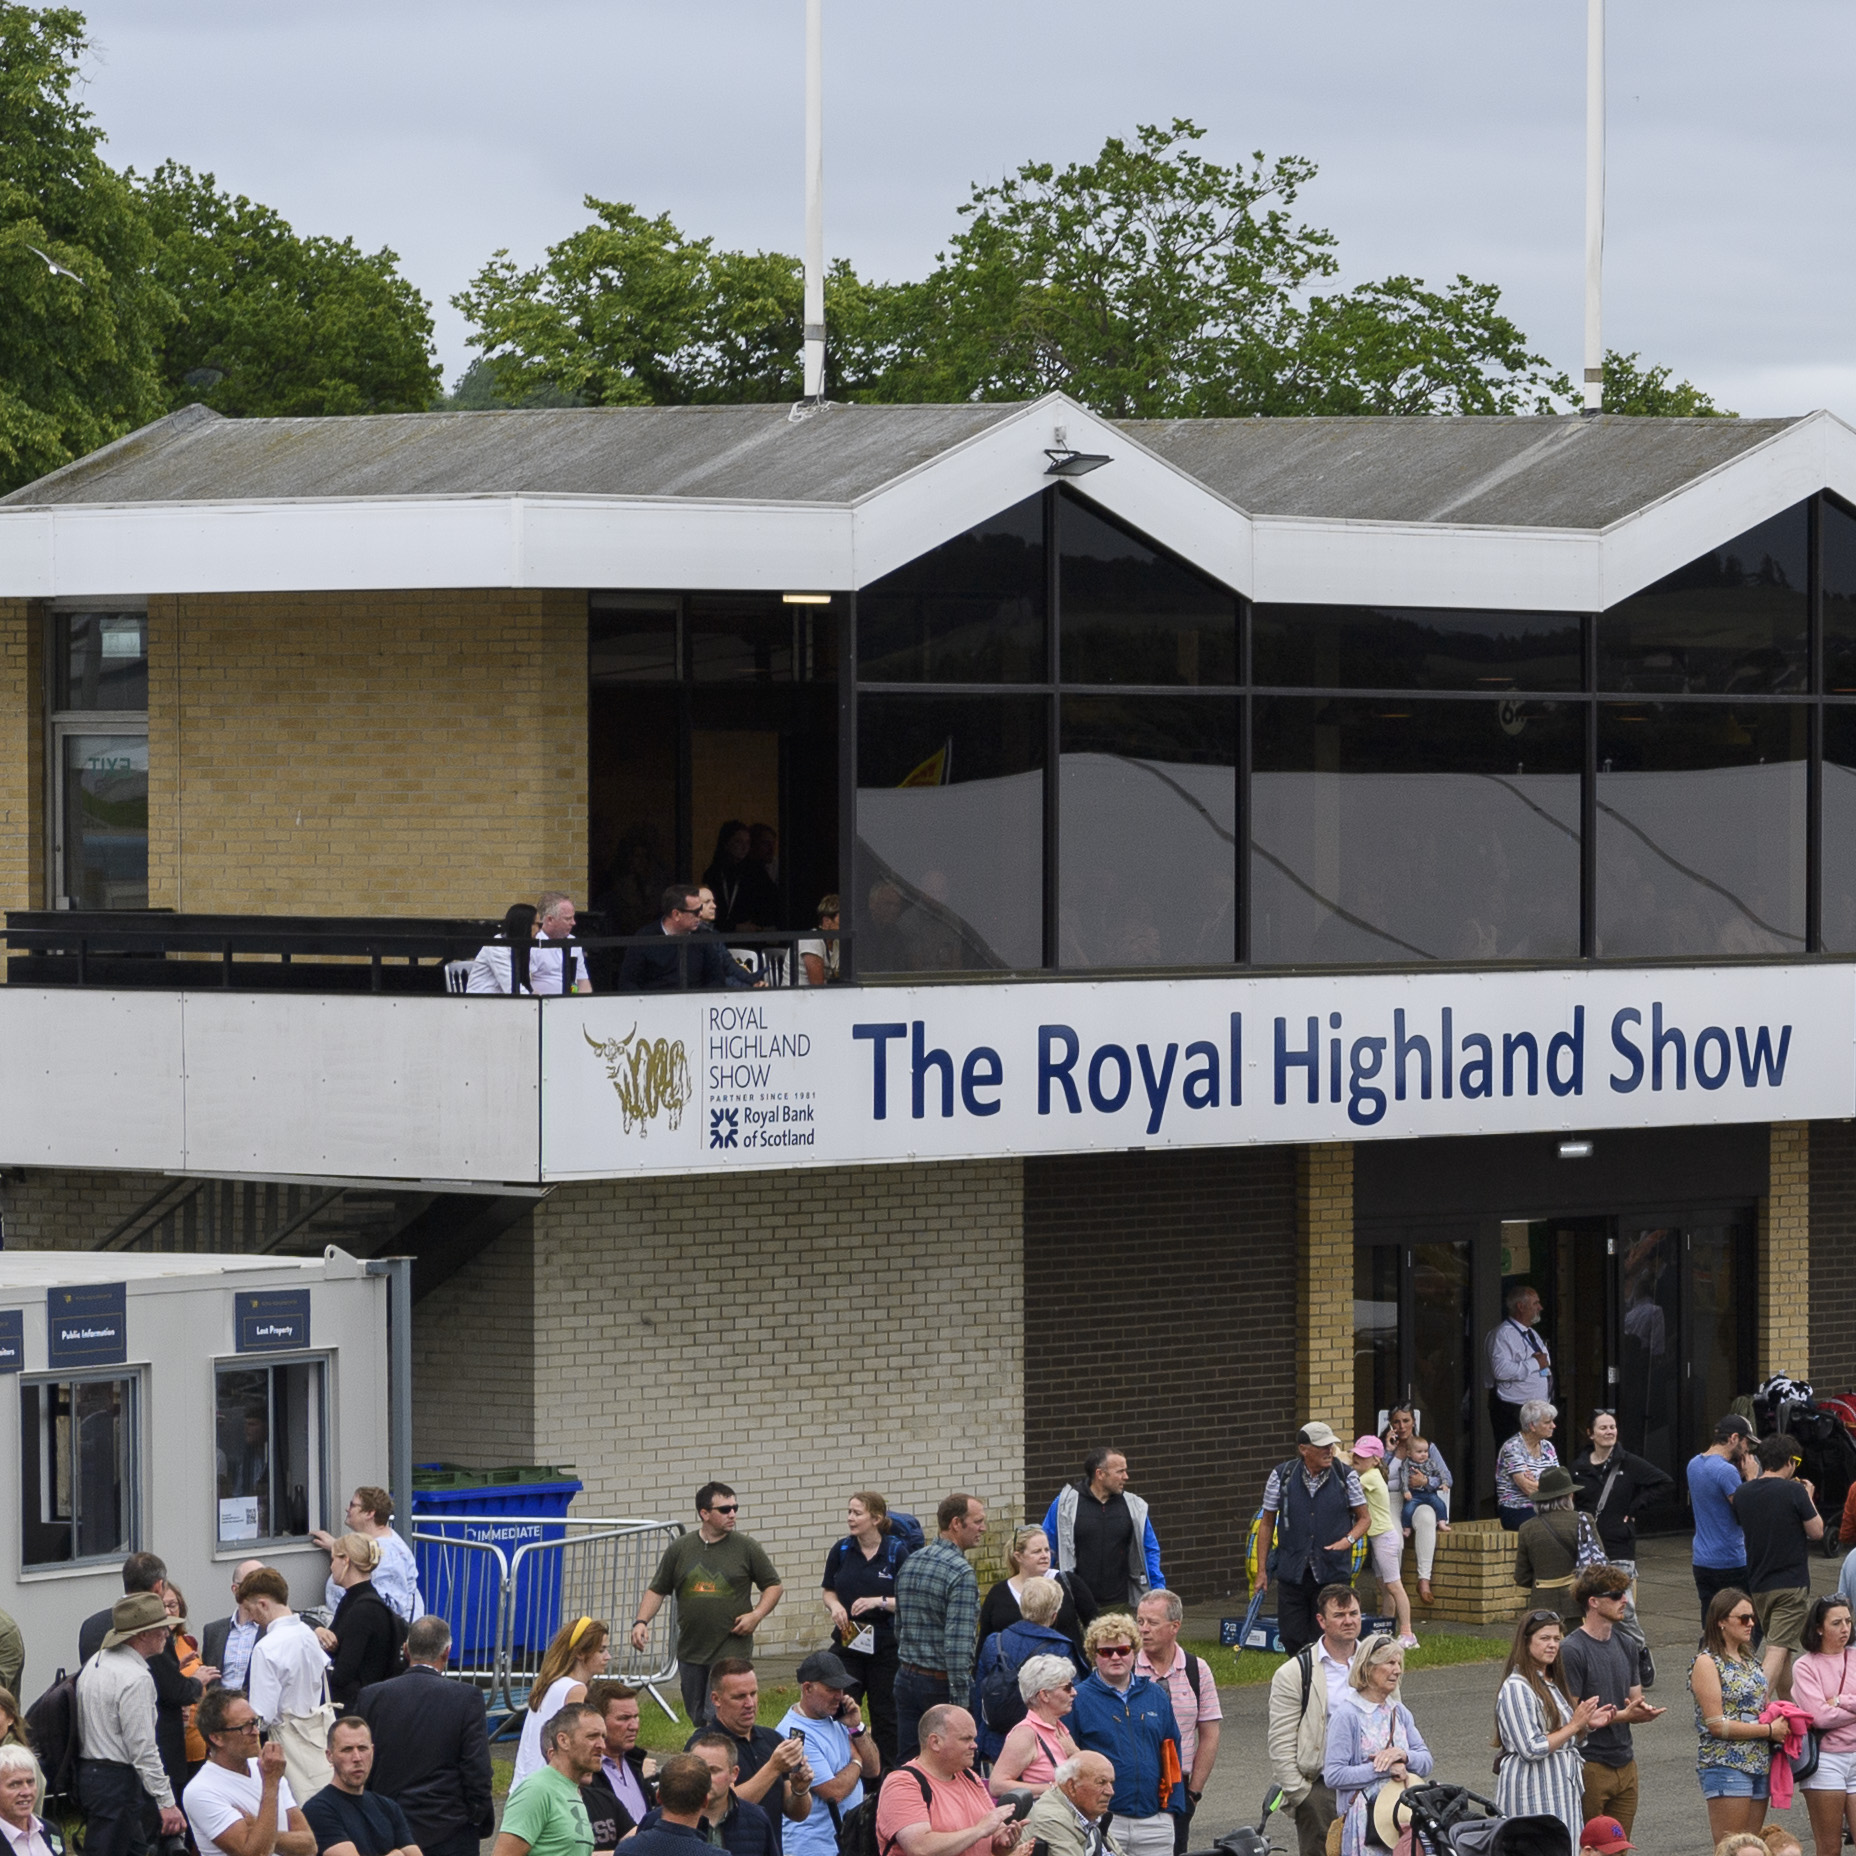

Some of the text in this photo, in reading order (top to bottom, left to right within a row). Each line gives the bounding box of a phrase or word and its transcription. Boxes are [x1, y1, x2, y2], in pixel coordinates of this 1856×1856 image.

[710, 1006, 767, 1031] ROYAL
[710, 1034, 811, 1060] HIGHLAND
[709, 1064, 771, 1089] SHOW
[852, 1001, 1792, 1135] The Royal Highland Show
[709, 1091, 816, 1102] PARTNER SINCE 1981
[744, 1105, 814, 1128] Royal Bank
[743, 1128, 815, 1147] of Scotland
[62, 1327, 116, 1340] Public Information
[256, 1325, 293, 1337] Lost Property
[477, 1525, 541, 1541] IMMEDIATE
